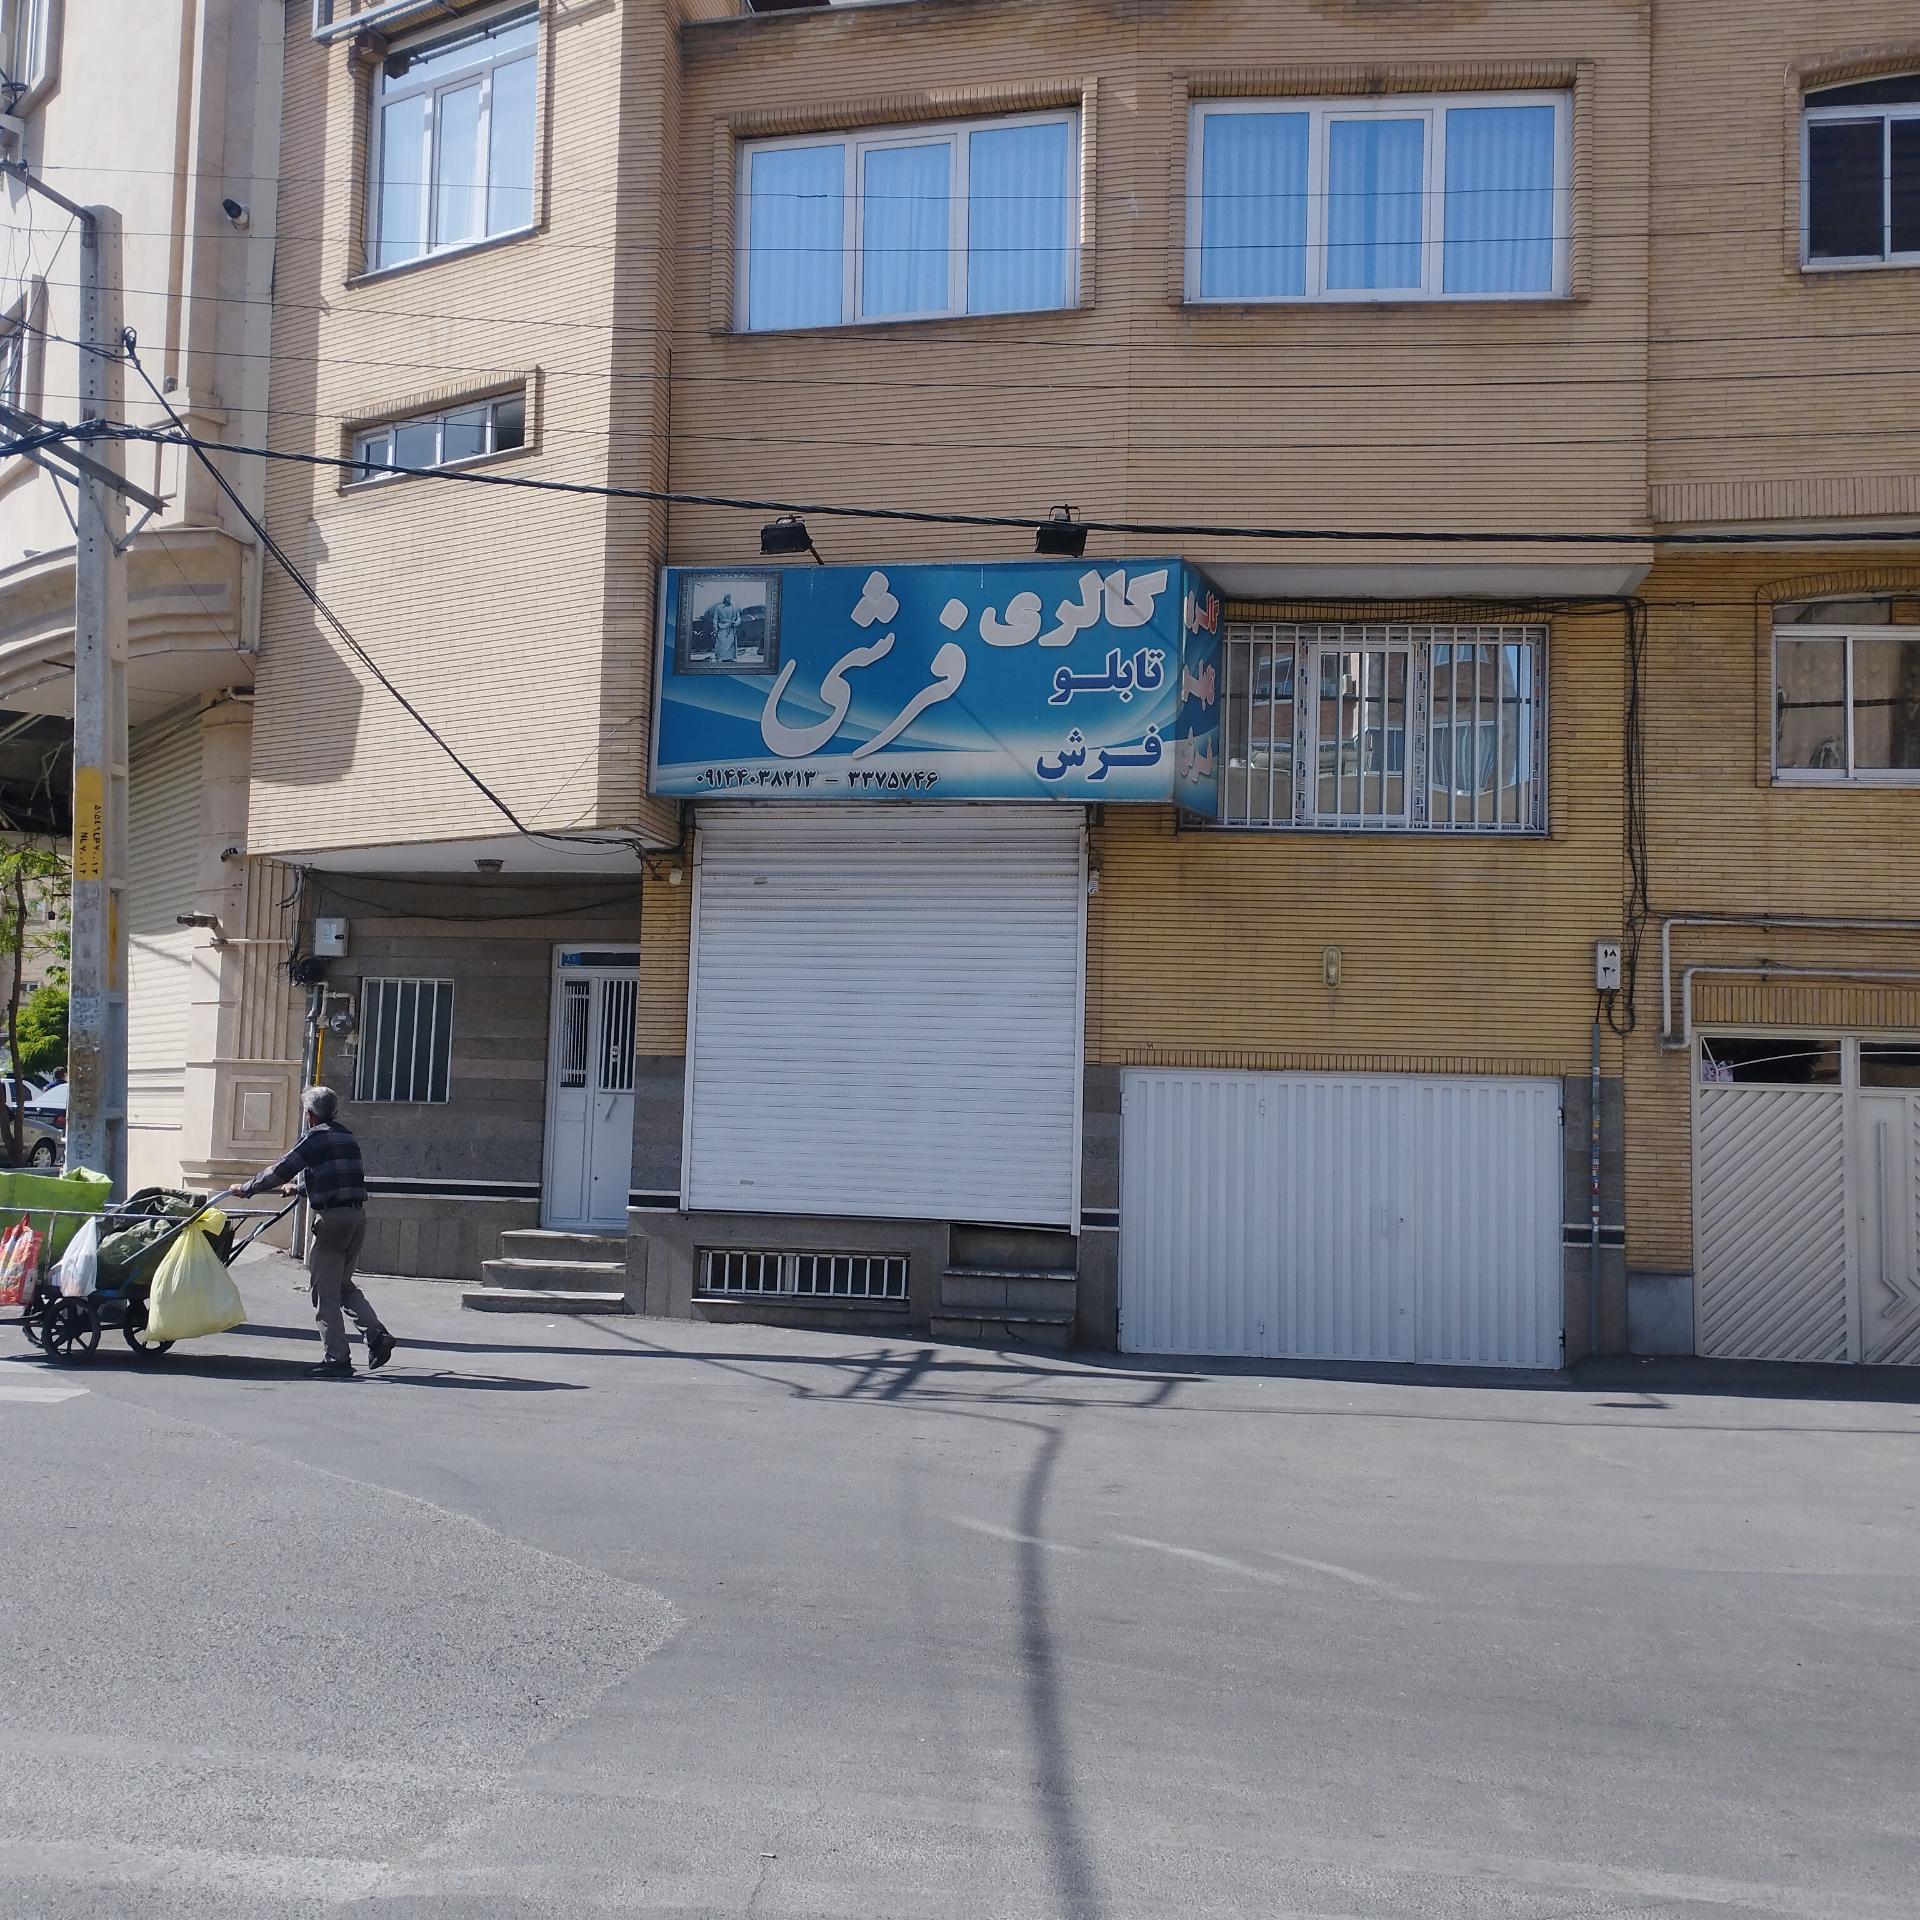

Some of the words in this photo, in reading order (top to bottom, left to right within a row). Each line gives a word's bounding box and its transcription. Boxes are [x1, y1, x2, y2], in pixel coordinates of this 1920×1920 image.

[979, 569, 1168, 647] گالری
[1047, 648, 1166, 706] تابلو
[696, 768, 817, 788] ۰۹۱۴۴۰۳۸۲۱۳
[848, 769, 940, 791] ۳۳۷۵۷۴۶
[1036, 724, 1162, 781] فرش
